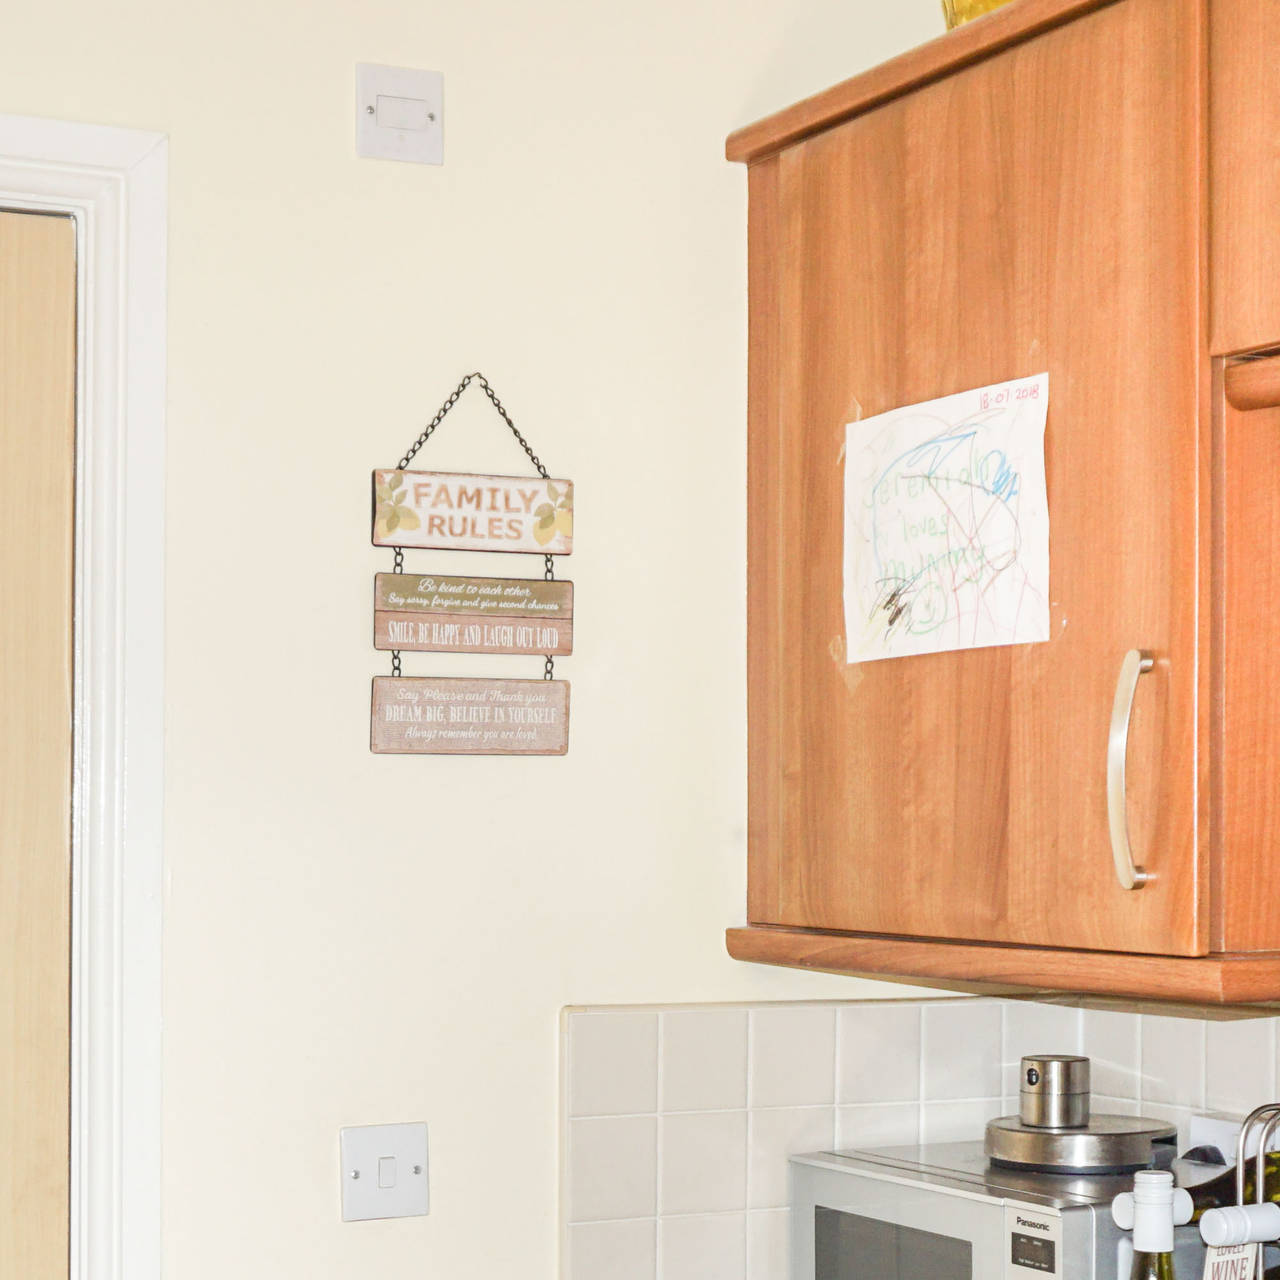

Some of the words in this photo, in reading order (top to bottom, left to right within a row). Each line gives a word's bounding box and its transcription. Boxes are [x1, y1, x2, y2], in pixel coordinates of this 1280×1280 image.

[412, 482, 540, 515] FAMILY
[427, 514, 524, 540] RULES
[418, 577, 436, 593] Be
[438, 581, 464, 594] kind
[467, 584, 479, 594] to
[418, 622, 431, 644] BE
[432, 623, 461, 645] HAPPY
[463, 624, 481, 646] AND
[483, 625, 514, 647] LAUGH
[516, 627, 534, 648] OUT
[535, 627, 559, 649] LOUD
[397, 688, 419, 704] Say
[423, 687, 464, 701] Please
[465, 689, 488, 701] and
[489, 689, 523, 702] Thank
[385, 704, 422, 722] DREAM
[450, 705, 491, 723] BELIEVE
[494, 706, 506, 723] IN
[508, 706, 557, 724] YOURSELF
[438, 727, 482, 739] remember
[1016, 1216, 1050, 1232] Panasonic
